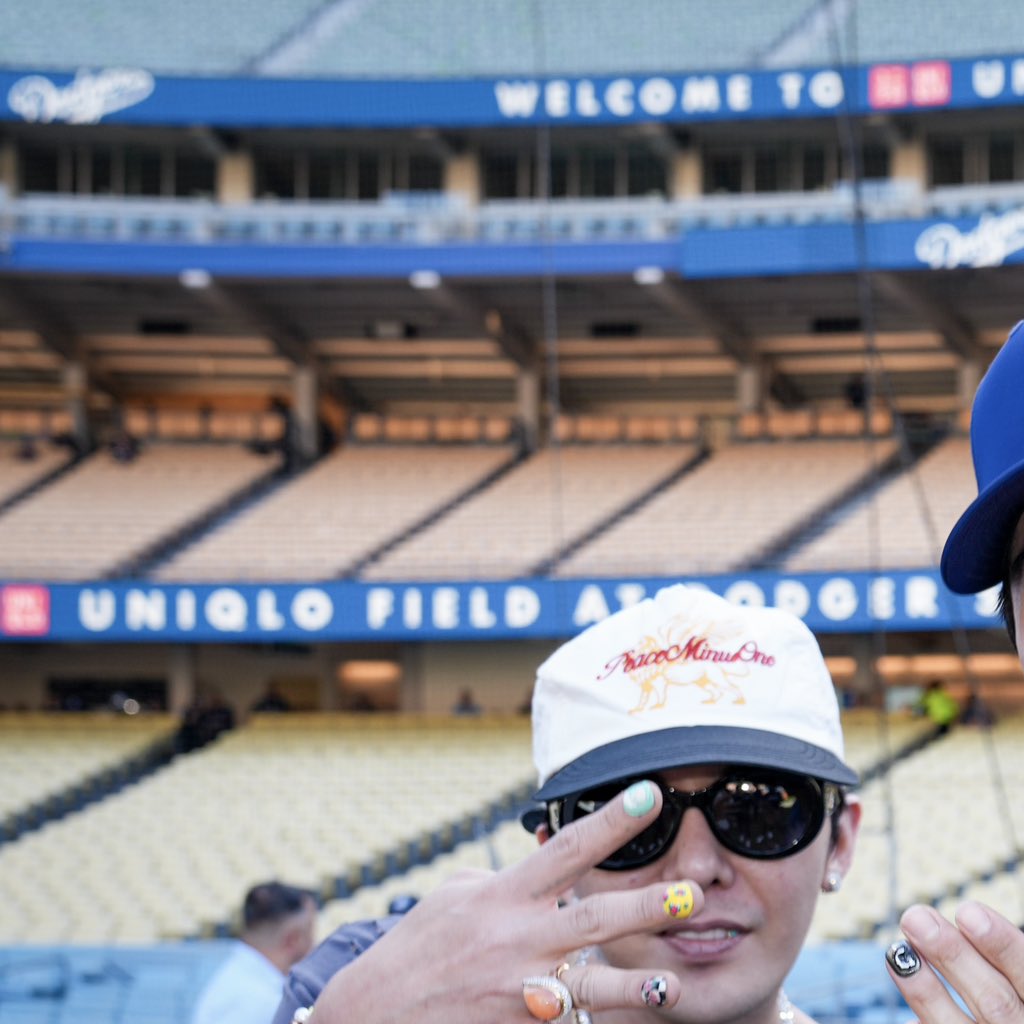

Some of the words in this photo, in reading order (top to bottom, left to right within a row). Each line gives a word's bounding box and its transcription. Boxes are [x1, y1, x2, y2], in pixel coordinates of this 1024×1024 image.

[495, 73, 751, 118] WELCOME
[778, 70, 844, 109] TO
[78, 587, 333, 632] UNIQLO
[366, 585, 541, 630] FIELD
[684, 576, 940, 621] ODGER
